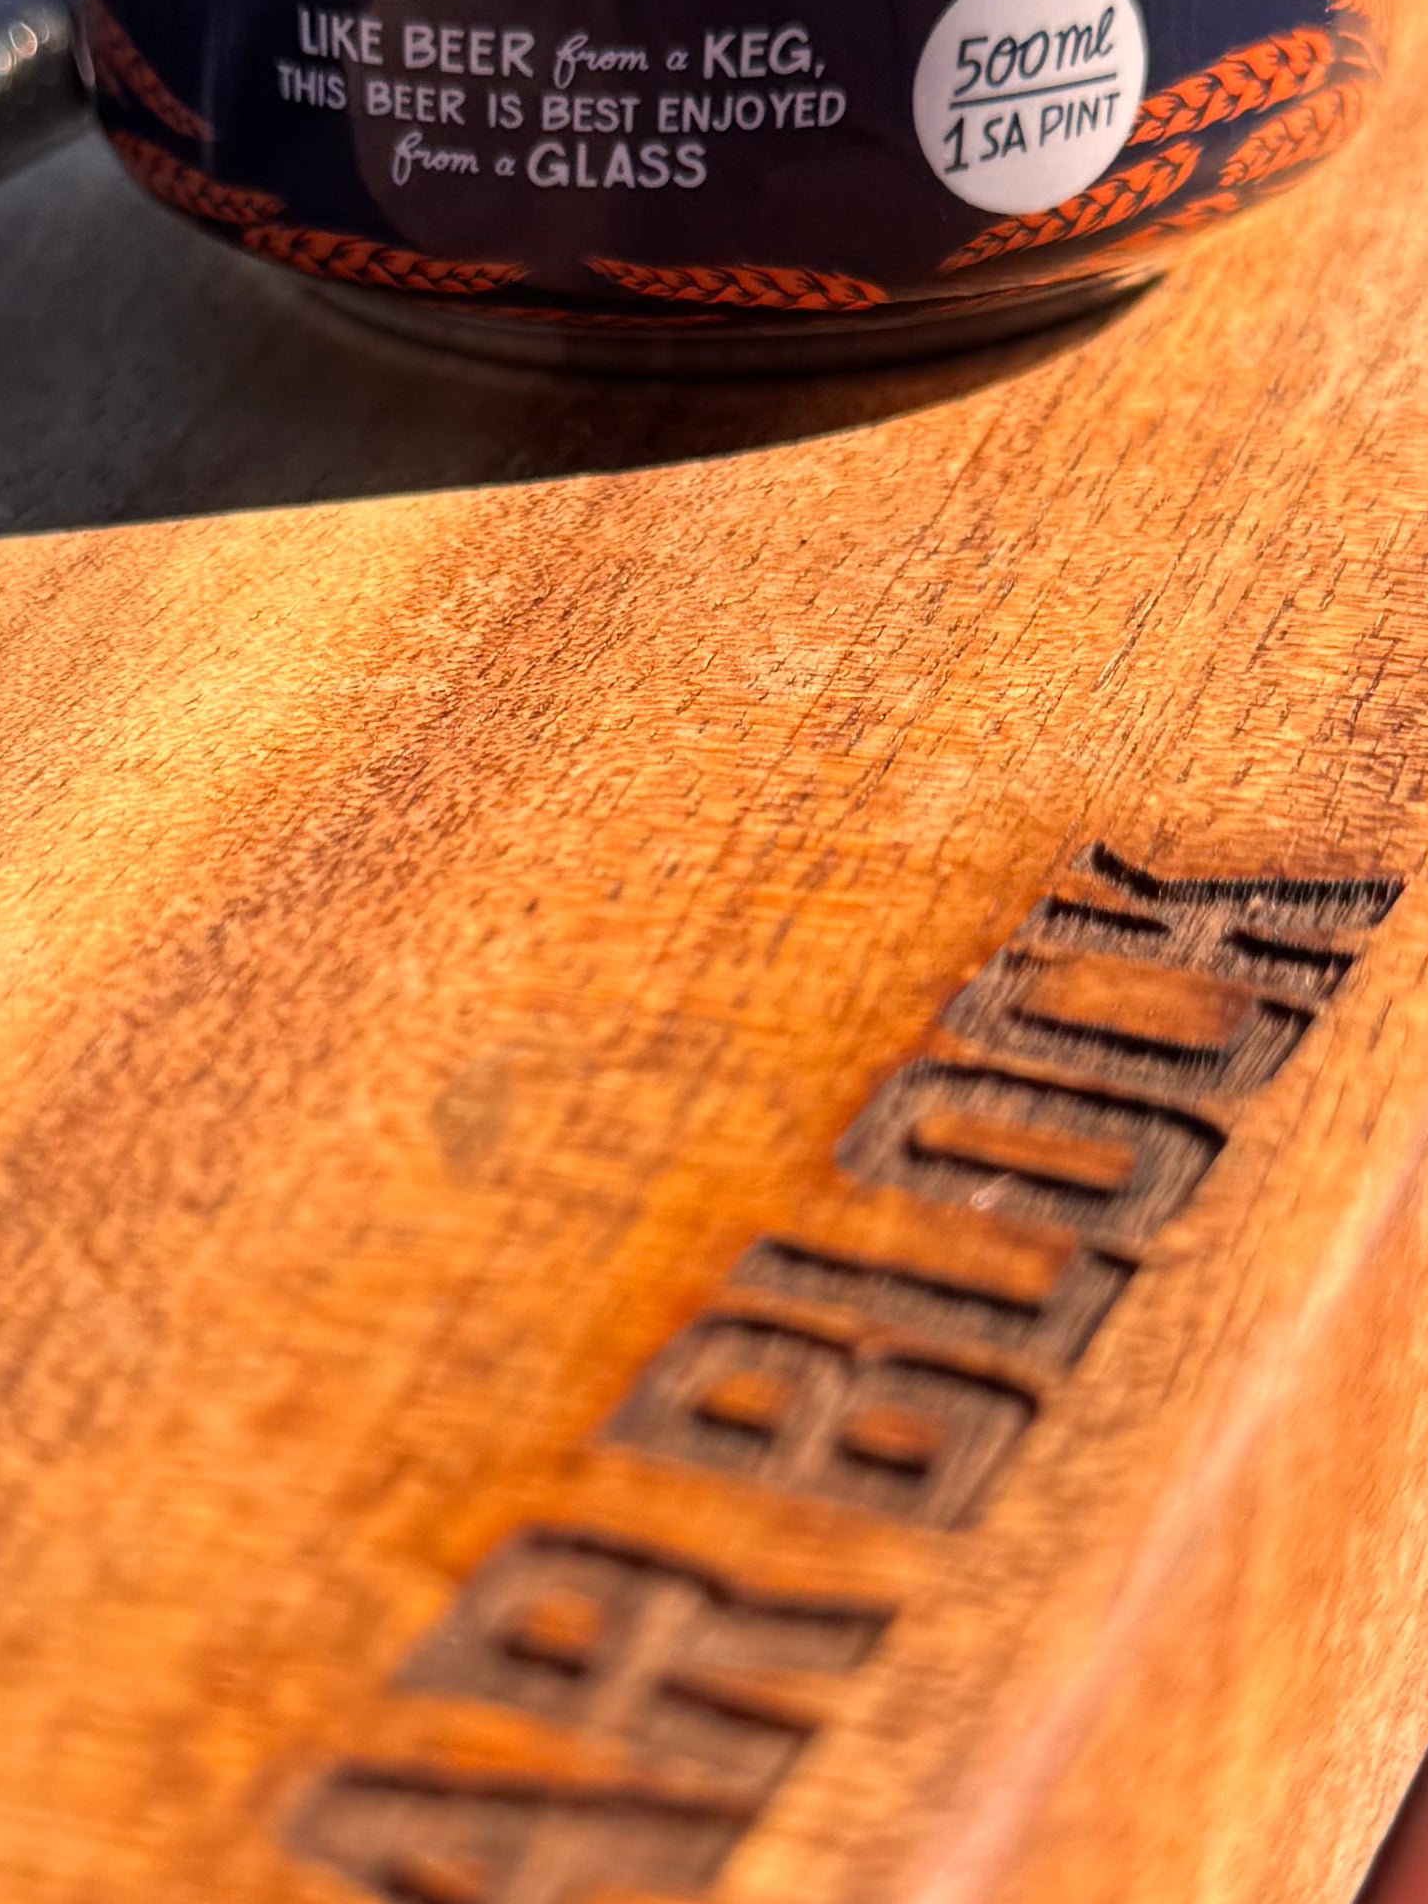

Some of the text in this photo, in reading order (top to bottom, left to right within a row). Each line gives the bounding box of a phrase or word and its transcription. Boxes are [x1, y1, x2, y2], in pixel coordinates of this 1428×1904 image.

[297, 3, 825, 88] LIKE BEER from a KEG,
[954, 6, 1115, 96] 500ml
[276, 59, 846, 132] THIS BEER IS BEST ENJOYED
[943, 92, 1120, 174] 1 SA PINT
[391, 130, 707, 188] from a GLASS
[600, 842, 1405, 1530] BLOCK
